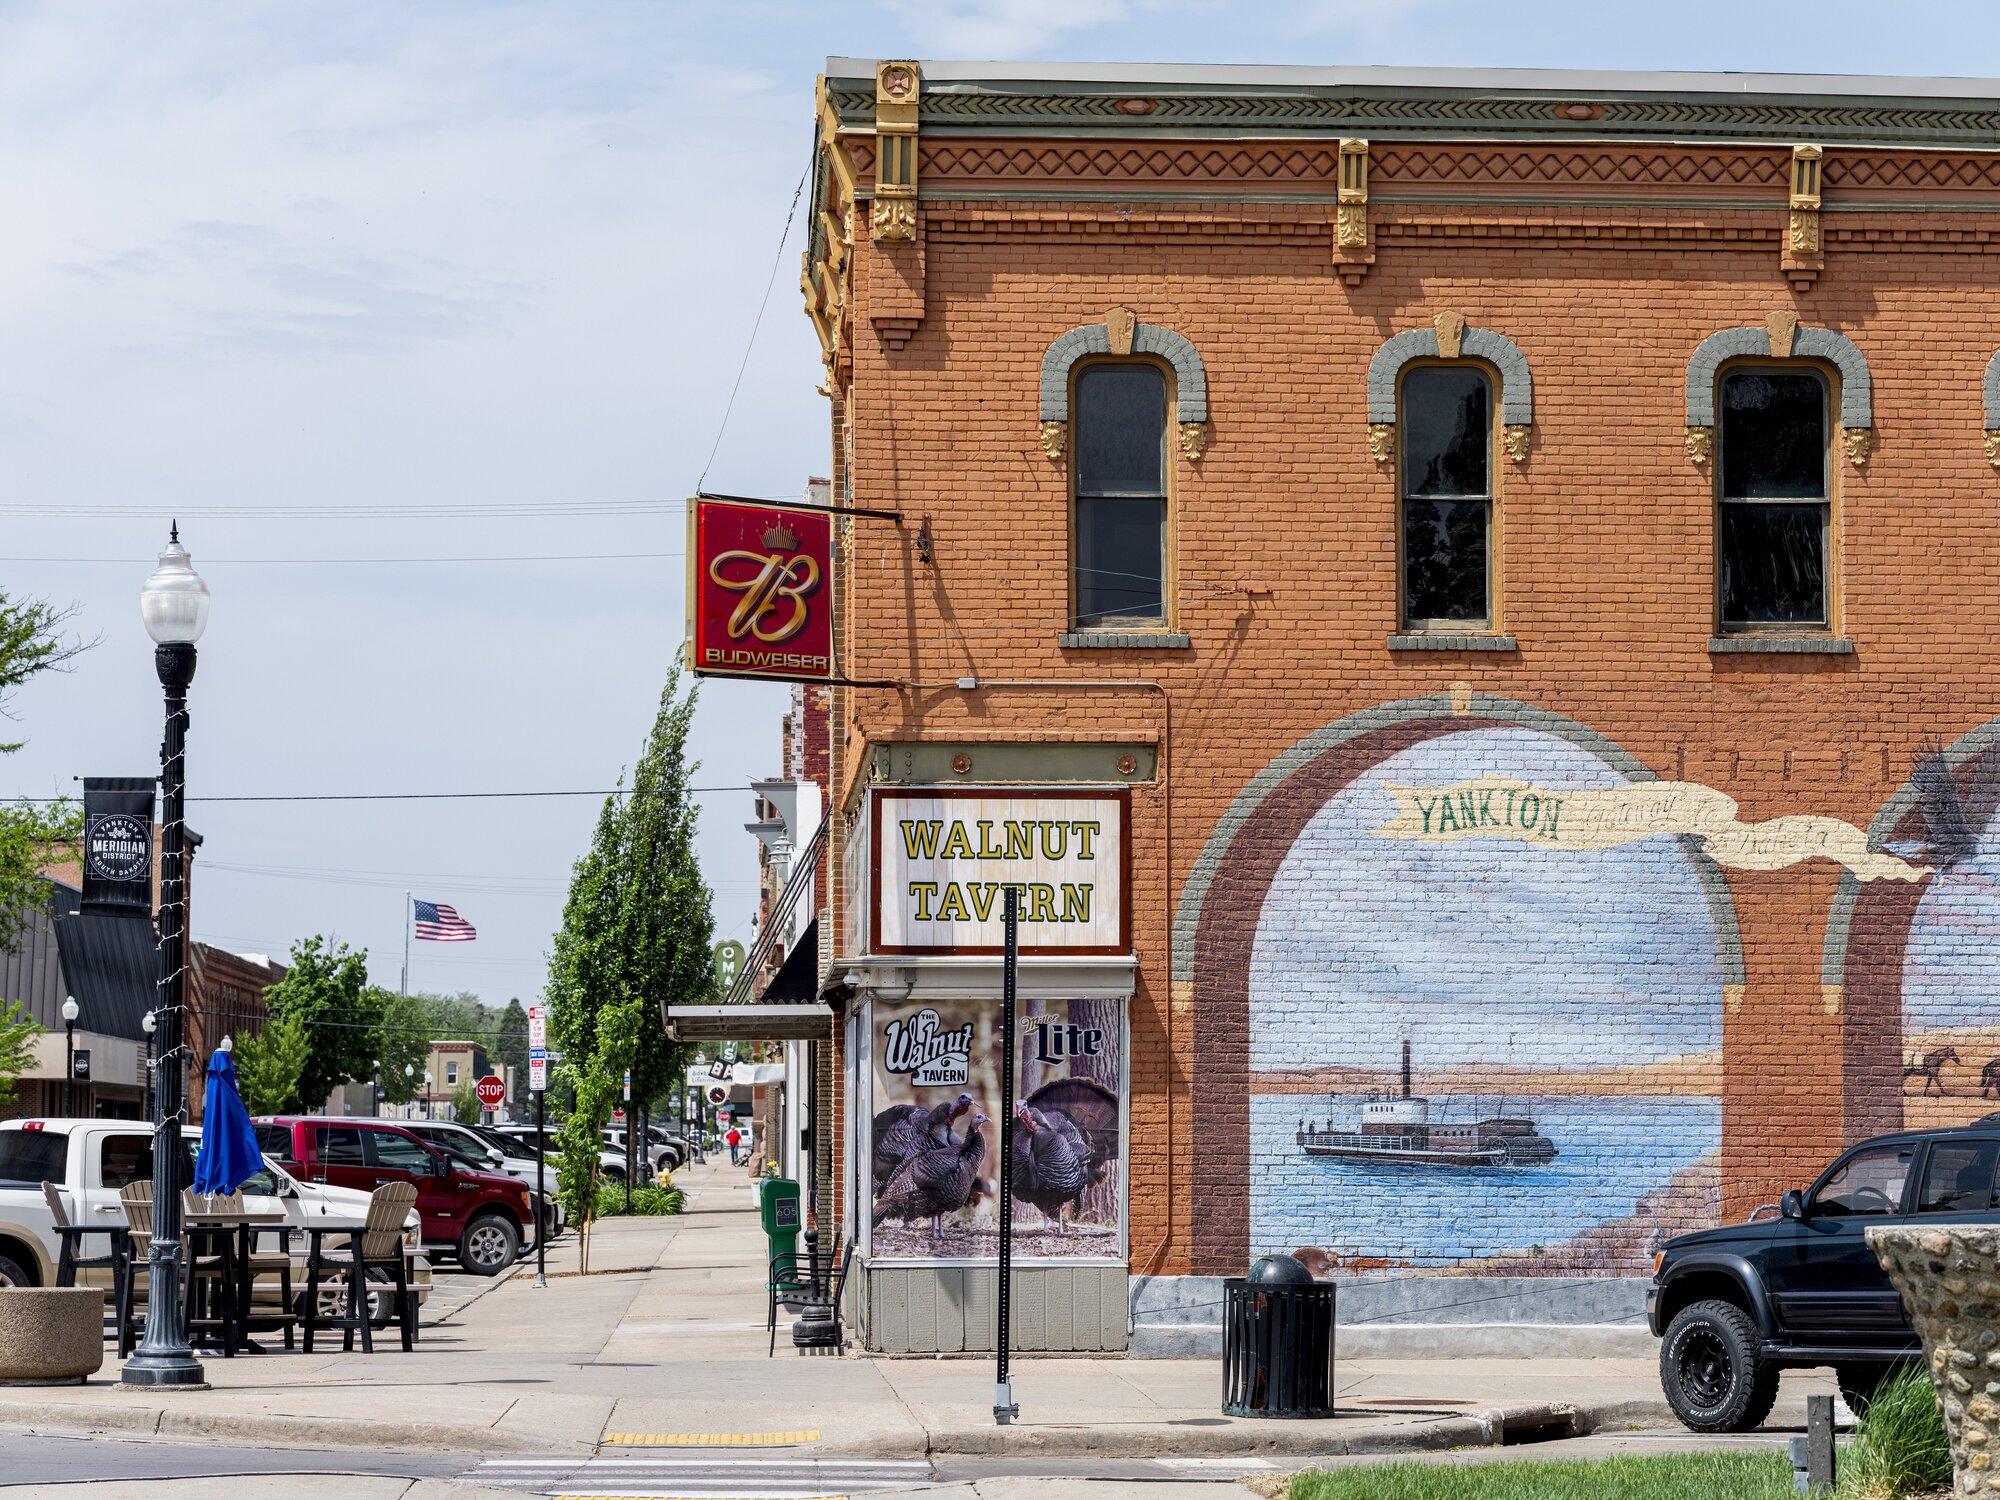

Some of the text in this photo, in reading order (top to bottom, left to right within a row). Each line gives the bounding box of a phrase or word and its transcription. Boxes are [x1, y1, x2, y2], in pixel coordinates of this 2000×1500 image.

[705, 648, 828, 669] BUDWEISER
[1413, 789, 1563, 840] YANKTON
[100, 820, 139, 832] YANKTON
[93, 840, 146, 854] MERIDIAN
[901, 820, 1100, 860] WALNUT
[94, 856, 144, 876] SOUTH DAKOTA
[102, 852, 136, 860] DISTRICT
[1020, 1013, 1060, 1033] Miller
[885, 1016, 973, 1072] Walnut
[1034, 1023, 1103, 1066] Lite
[922, 1069, 966, 1082] TAVERN
[478, 1084, 504, 1096] STOP
[777, 1207, 797, 1217] 605
[1668, 1320, 1710, 1360] BFGoodrich
